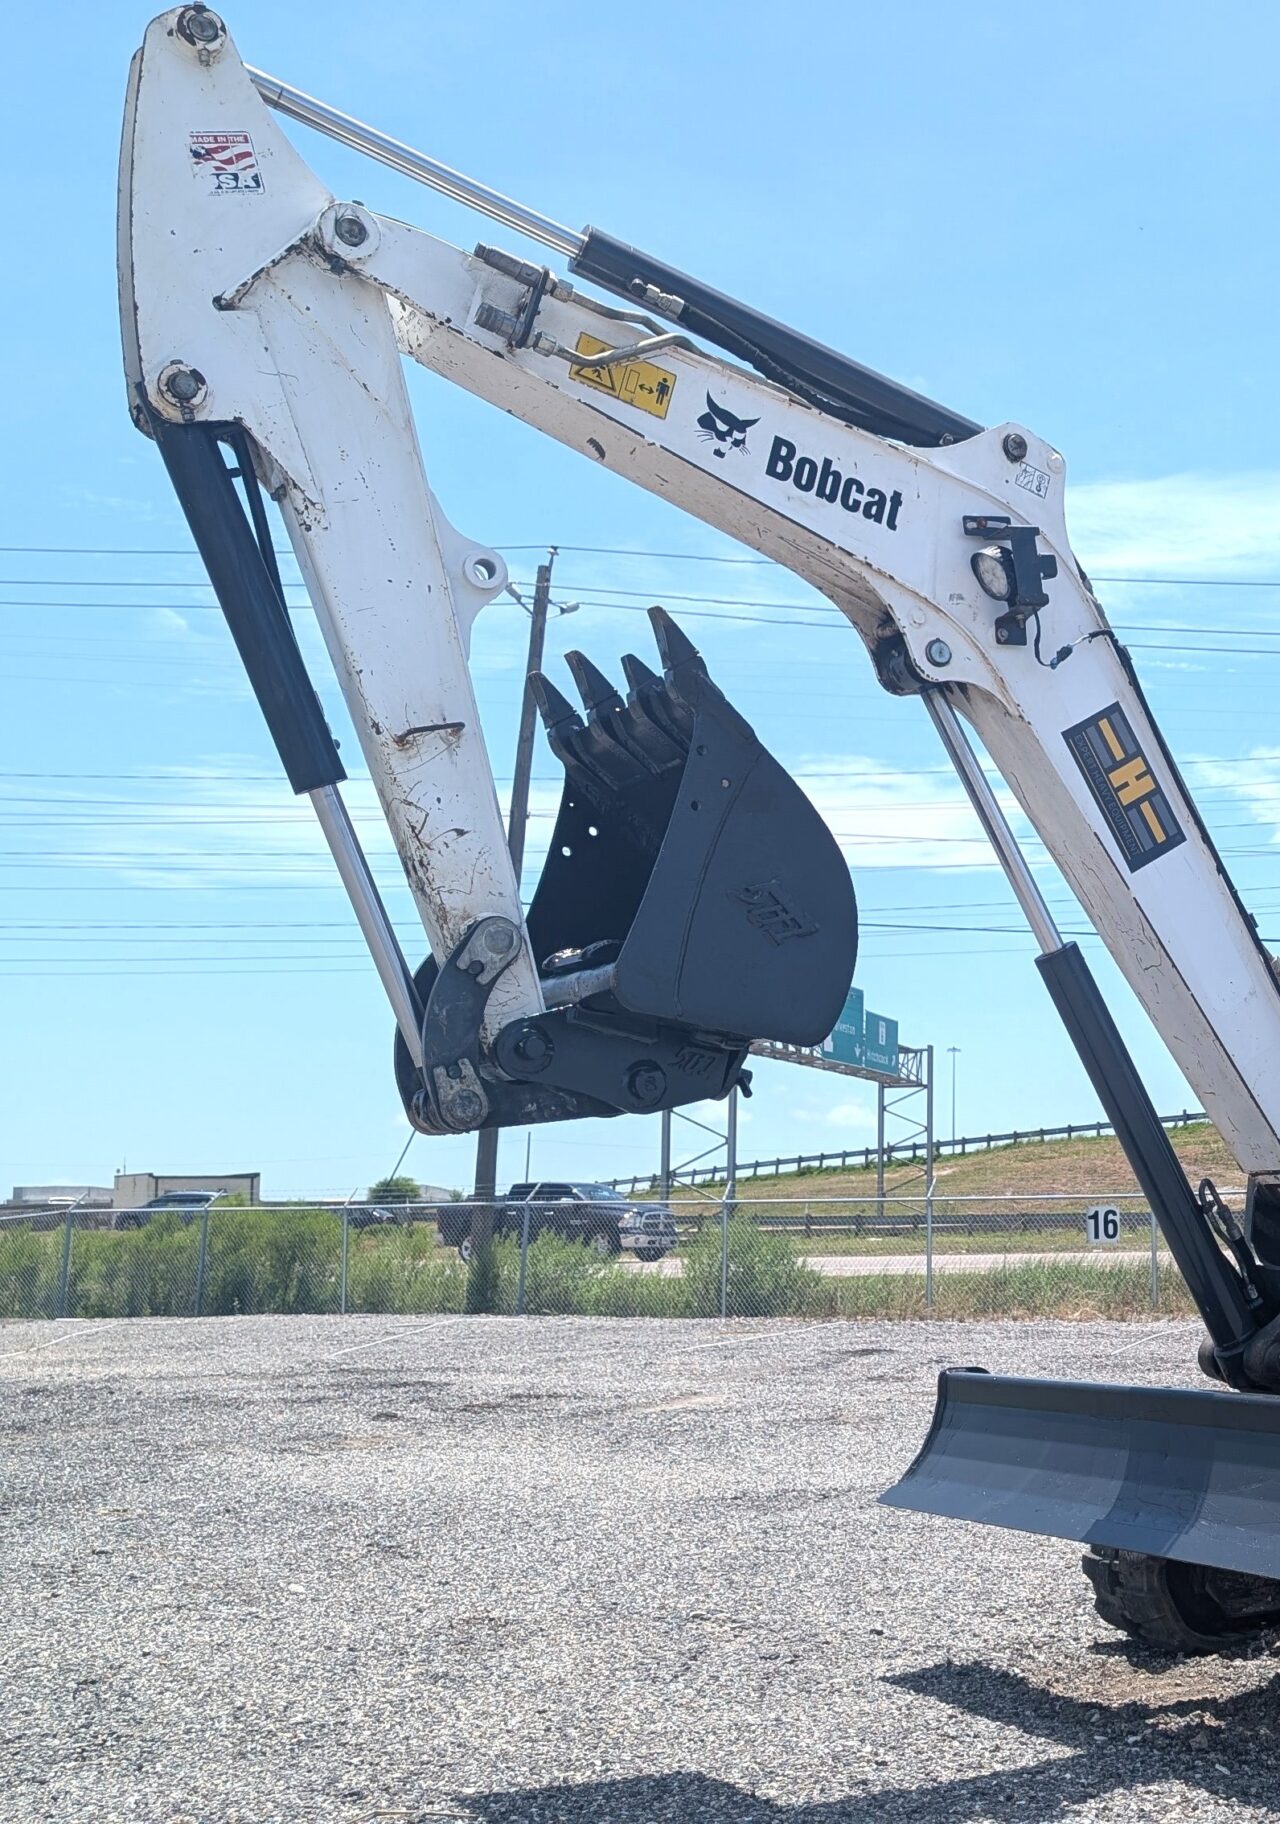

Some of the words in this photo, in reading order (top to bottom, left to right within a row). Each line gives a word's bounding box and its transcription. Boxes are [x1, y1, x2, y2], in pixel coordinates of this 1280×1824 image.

[216, 173, 258, 188] SA
[765, 435, 903, 531] Bobcat
[1074, 734, 1097, 771] EXPERT
[1091, 768, 1112, 801] HEAVY
[1108, 800, 1141, 857] EQUIPMENT
[1108, 756, 1156, 806] H
[1088, 1209, 1118, 1239] 16
